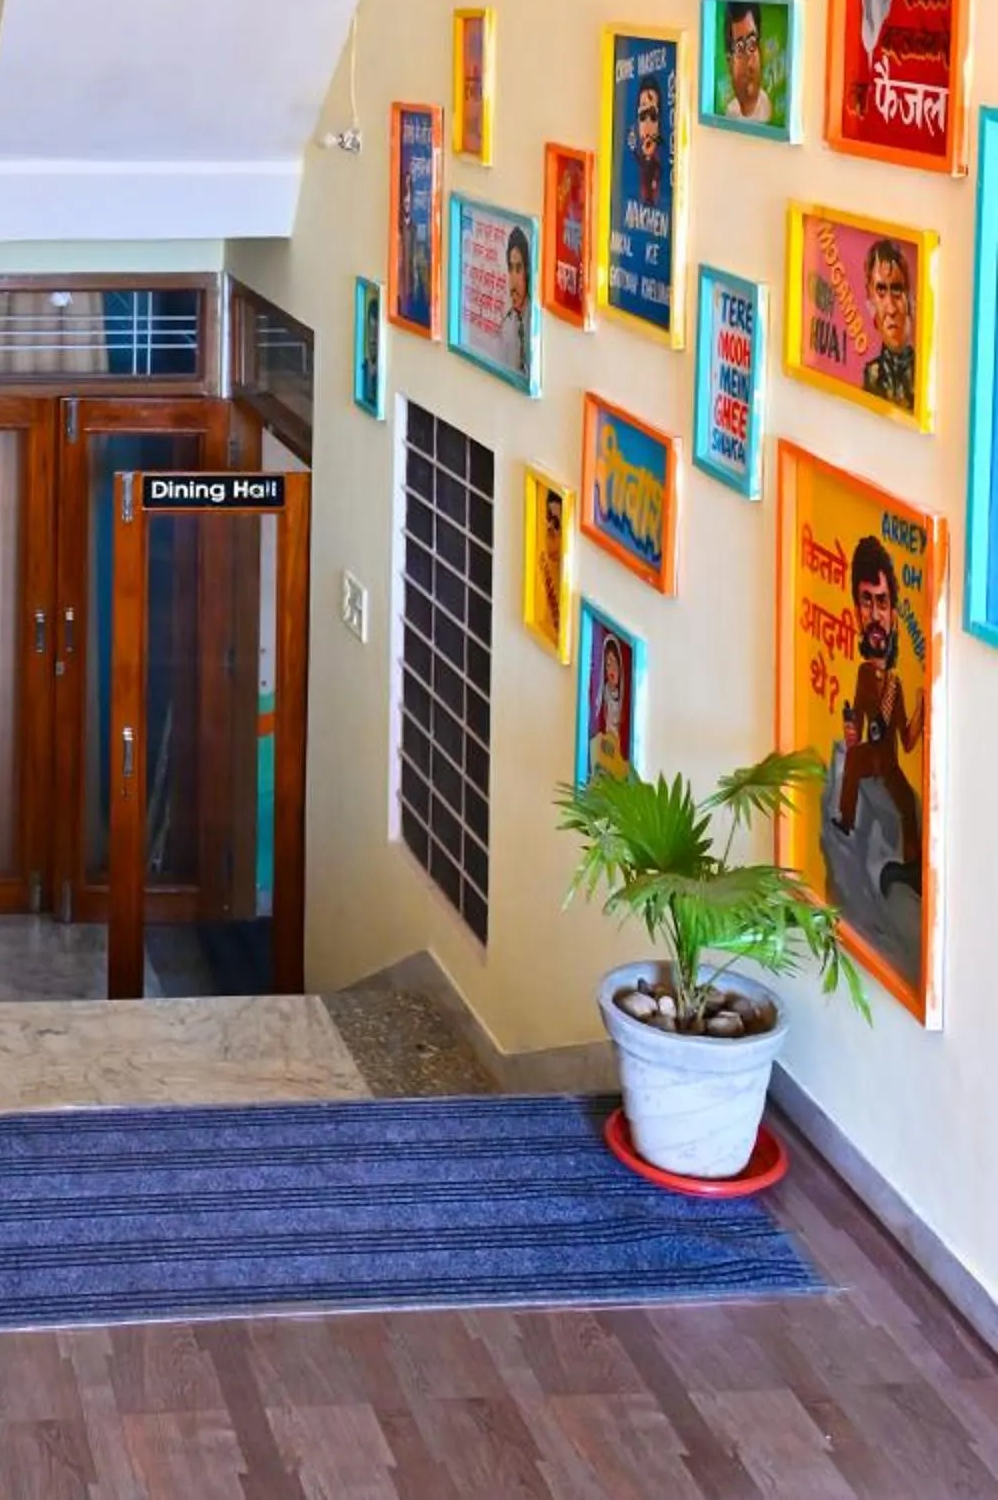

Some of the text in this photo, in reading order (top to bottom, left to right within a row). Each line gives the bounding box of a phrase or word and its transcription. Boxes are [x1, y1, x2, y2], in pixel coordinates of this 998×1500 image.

[873, 55, 949, 136] फैजल
[721, 291, 752, 334] TERE
[719, 362, 749, 404] MEIN
[713, 393, 749, 442] GHEE
[151, 480, 277, 503] Dining Hall
[801, 520, 849, 592] कितने
